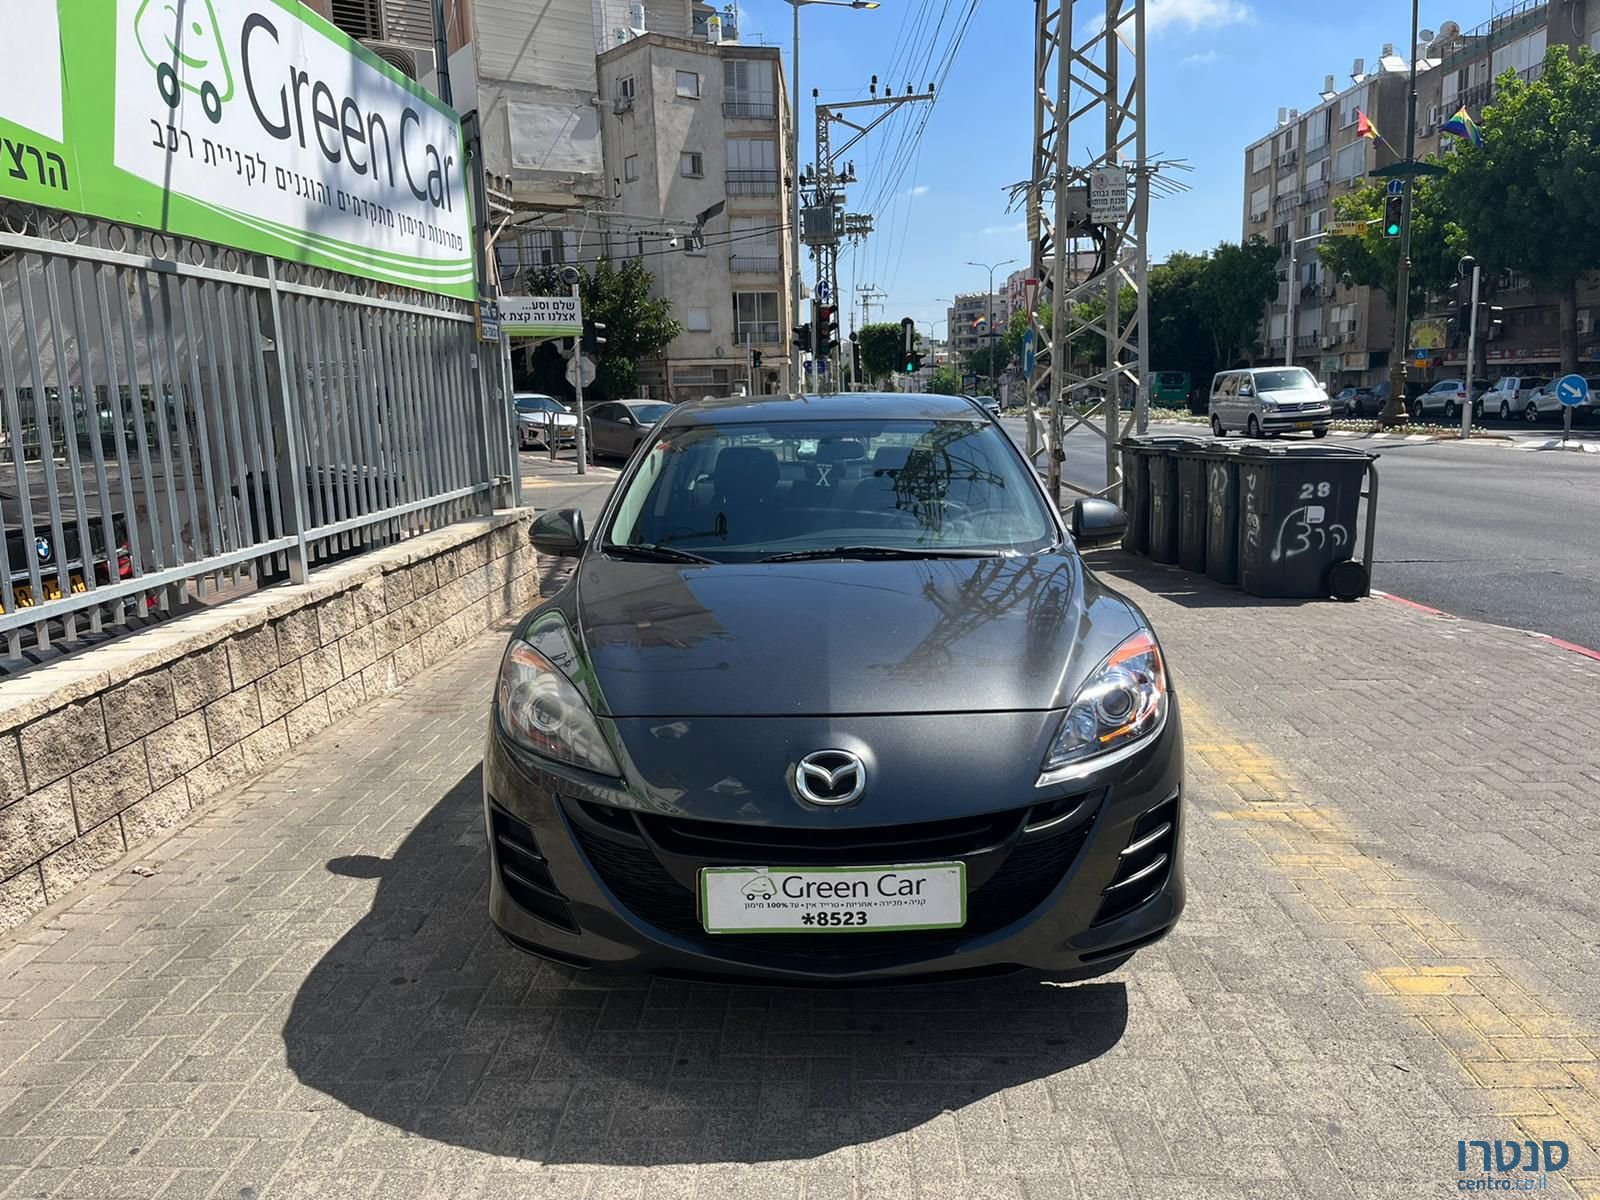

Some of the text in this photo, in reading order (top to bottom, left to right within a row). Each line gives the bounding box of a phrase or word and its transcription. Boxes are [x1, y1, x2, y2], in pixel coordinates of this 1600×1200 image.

[241, 13, 453, 213] Green Car
[0, 137, 68, 191] הרצ
[150, 119, 463, 251] פתרונות מימון מתקדמים והוגנים לקניית רכב
[553, 301, 575, 310] שלם
[509, 312, 531, 323] קצת
[534, 312, 545, 321] זה
[549, 311, 576, 321] אצלנו
[1300, 482, 1330, 499] 28
[782, 873, 926, 898] Green Car
